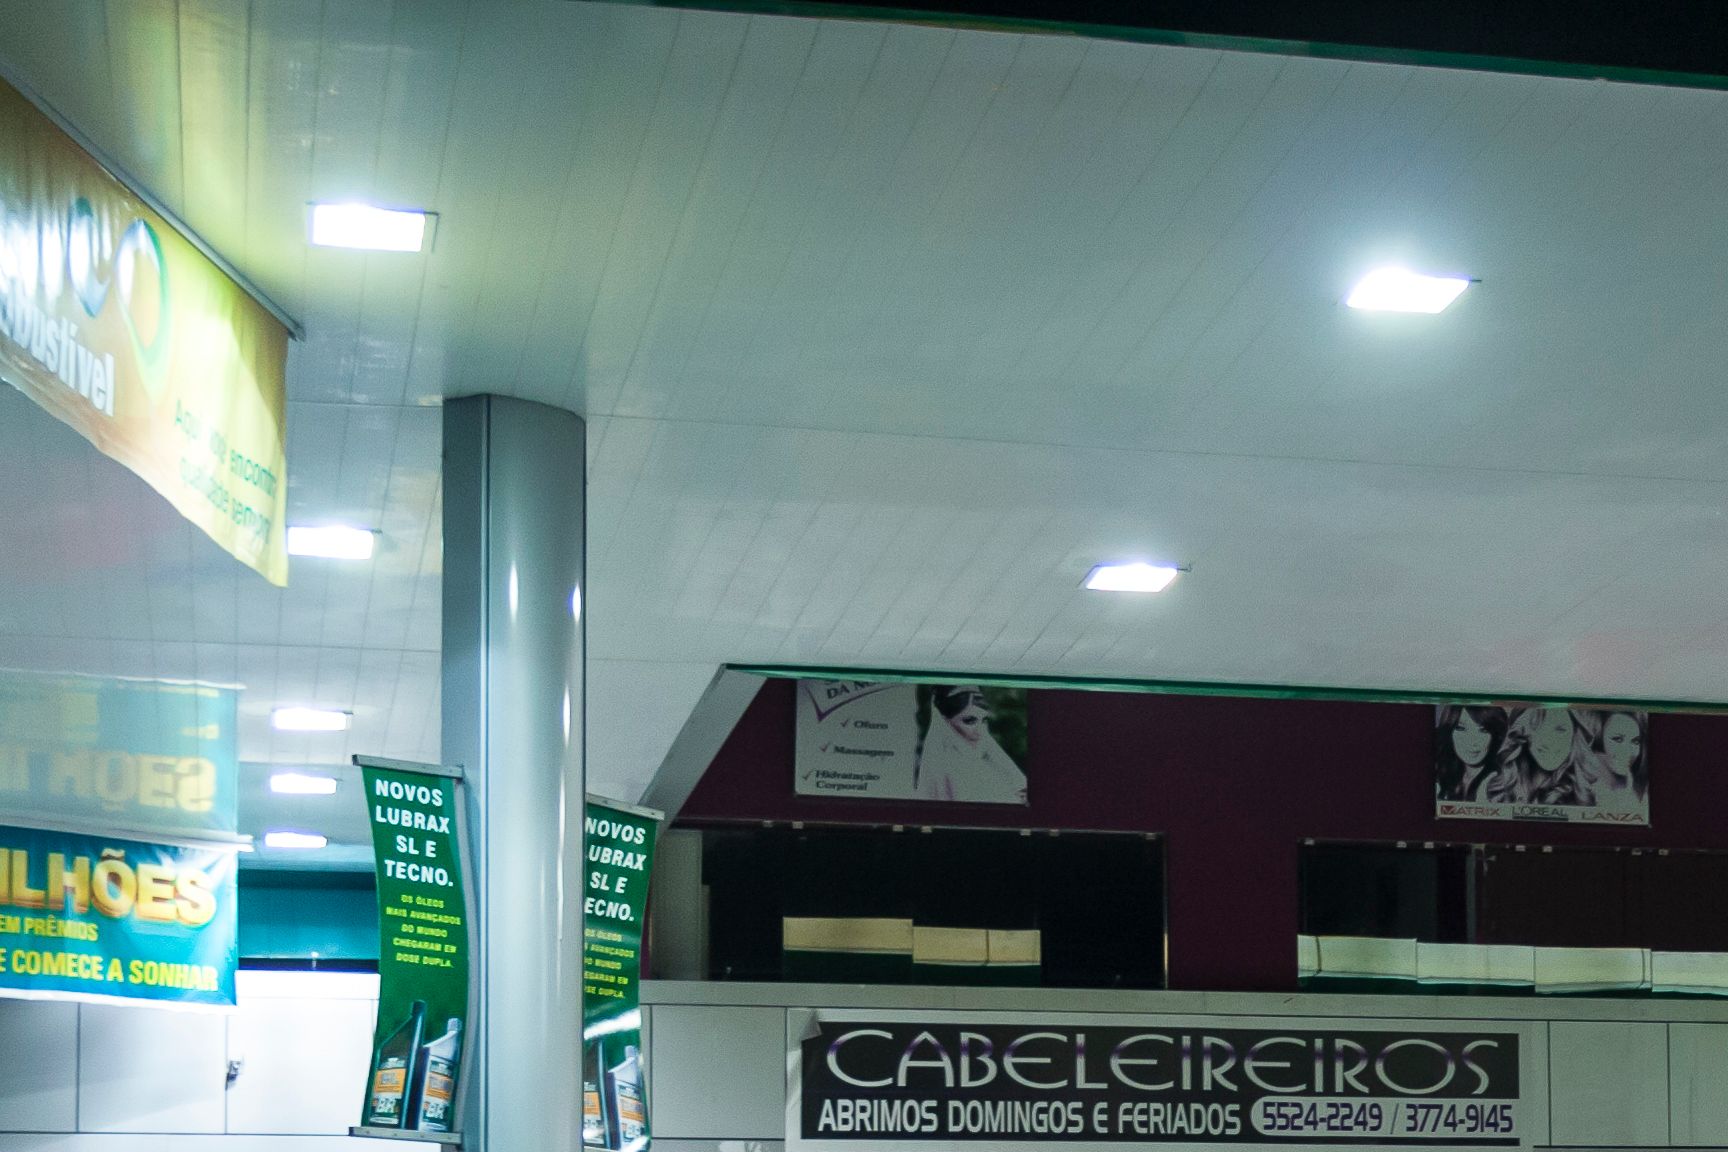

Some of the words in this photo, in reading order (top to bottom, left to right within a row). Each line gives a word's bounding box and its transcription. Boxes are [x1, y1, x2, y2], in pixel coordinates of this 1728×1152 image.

[376, 779, 443, 806] NOVOS
[375, 805, 450, 834] LUBRAX
[1440, 805, 1500, 816] MATRIX
[1581, 811, 1644, 822] LANZA
[585, 817, 646, 845] NOVOS
[396, 835, 419, 855] SL
[425, 840, 436, 858] E
[586, 844, 647, 871] UBRAX
[385, 860, 454, 887] TECNO.
[590, 872, 610, 891] SL
[615, 876, 628, 894] E
[584, 897, 634, 922] ECNO.
[23, 913, 99, 941] PRÊMIOS
[416, 926, 447, 938] MUNDO
[12, 949, 104, 981] COMECE
[106, 958, 125, 982] A
[129, 959, 219, 991] SONHAR
[826, 1028, 1499, 1097] CABELEIREIROS
[818, 1098, 938, 1134] ABRIMOS
[948, 1099, 1083, 1134] DOMINGOS
[1093, 1101, 1109, 1134] E
[1118, 1102, 1241, 1135] FERIADOS
[1262, 1101, 1384, 1134] 5524-2249
[1406, 1102, 1514, 1134] 3774-9145
